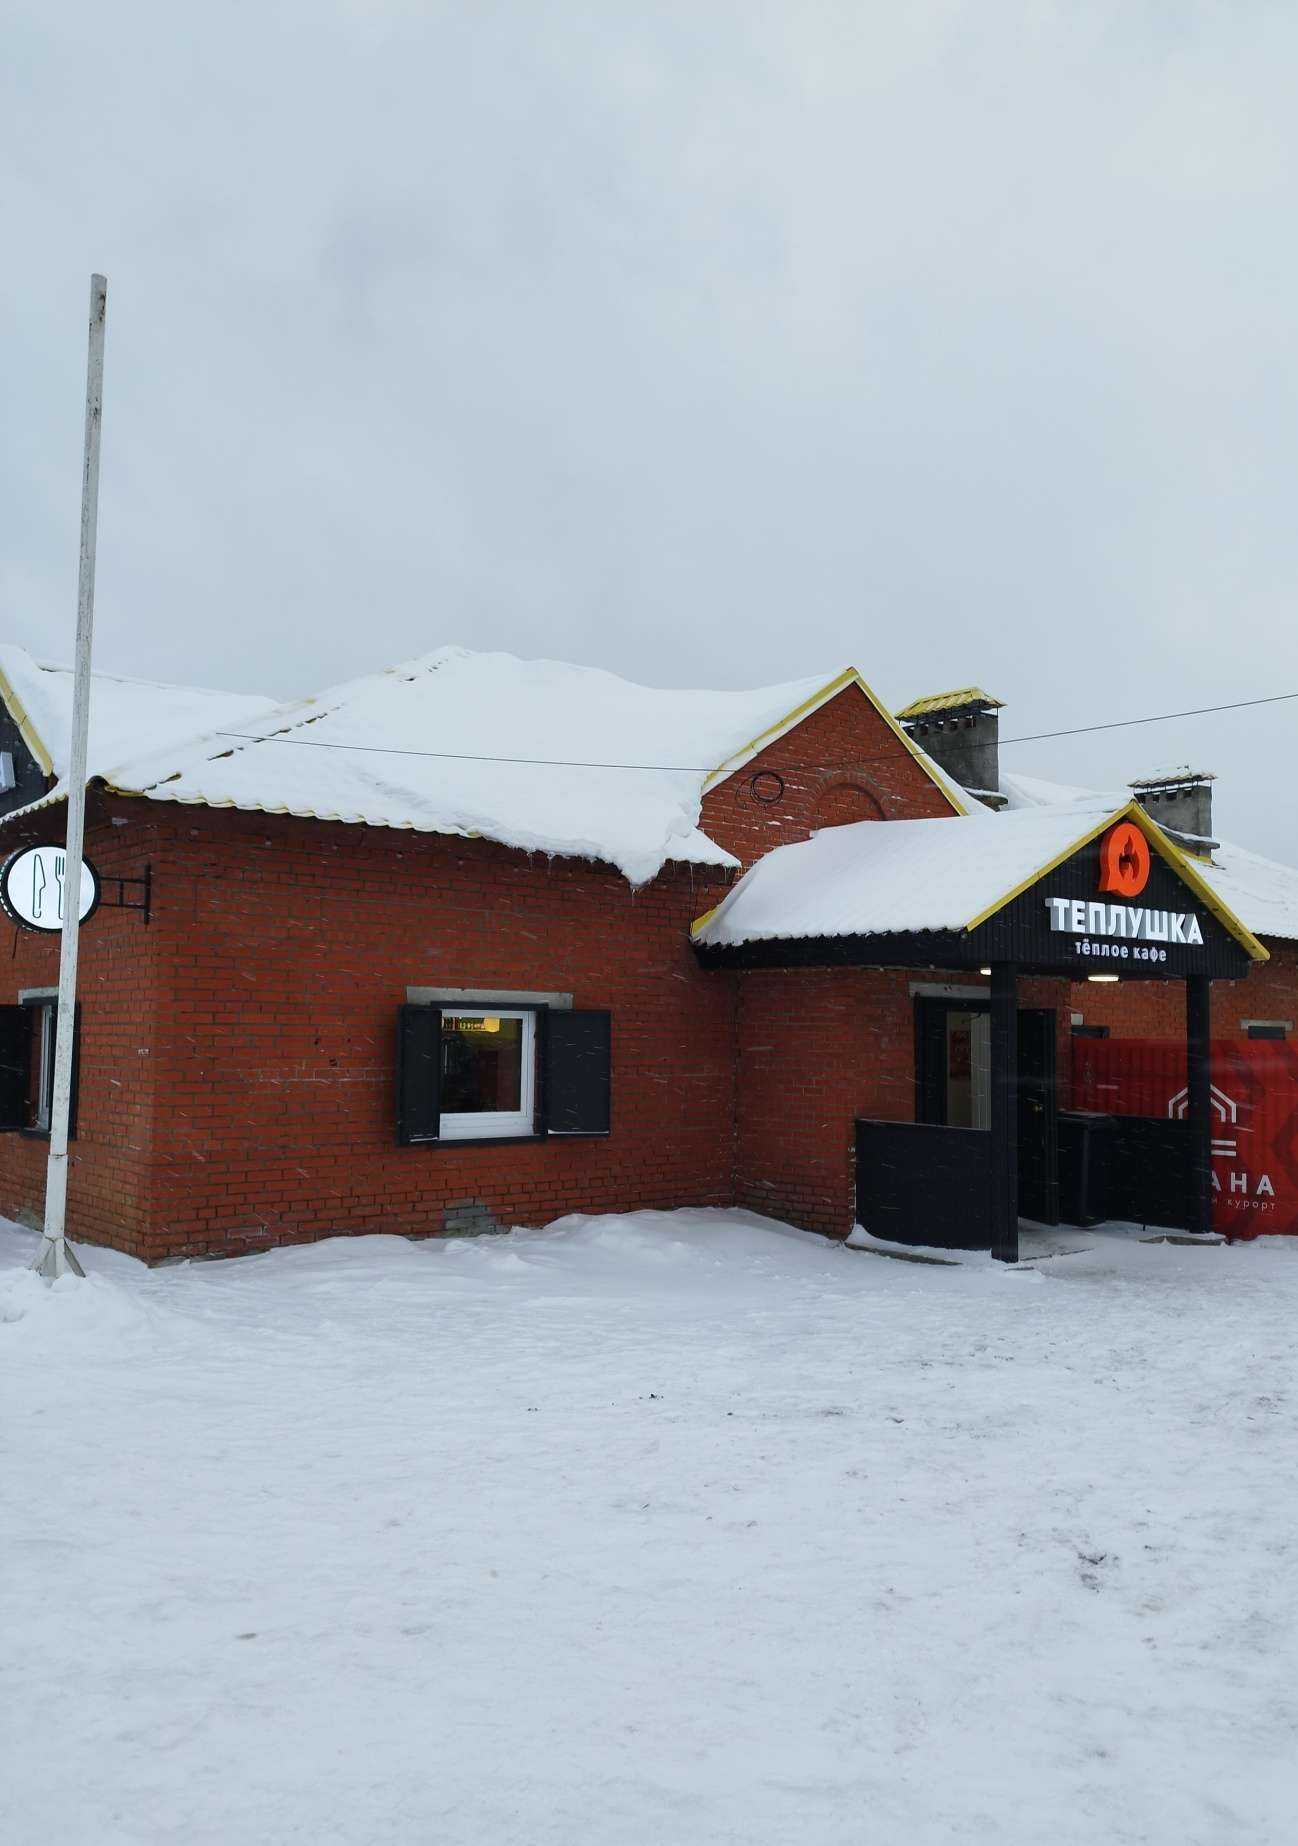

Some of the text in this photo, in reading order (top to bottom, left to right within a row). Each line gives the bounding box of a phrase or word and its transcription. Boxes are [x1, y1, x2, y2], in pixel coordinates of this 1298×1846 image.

[1046, 897, 1204, 945] ТЕПЛУШКА
[1075, 938, 1167, 963] тёплое кафе
[1227, 1199, 1277, 1211] курорт
